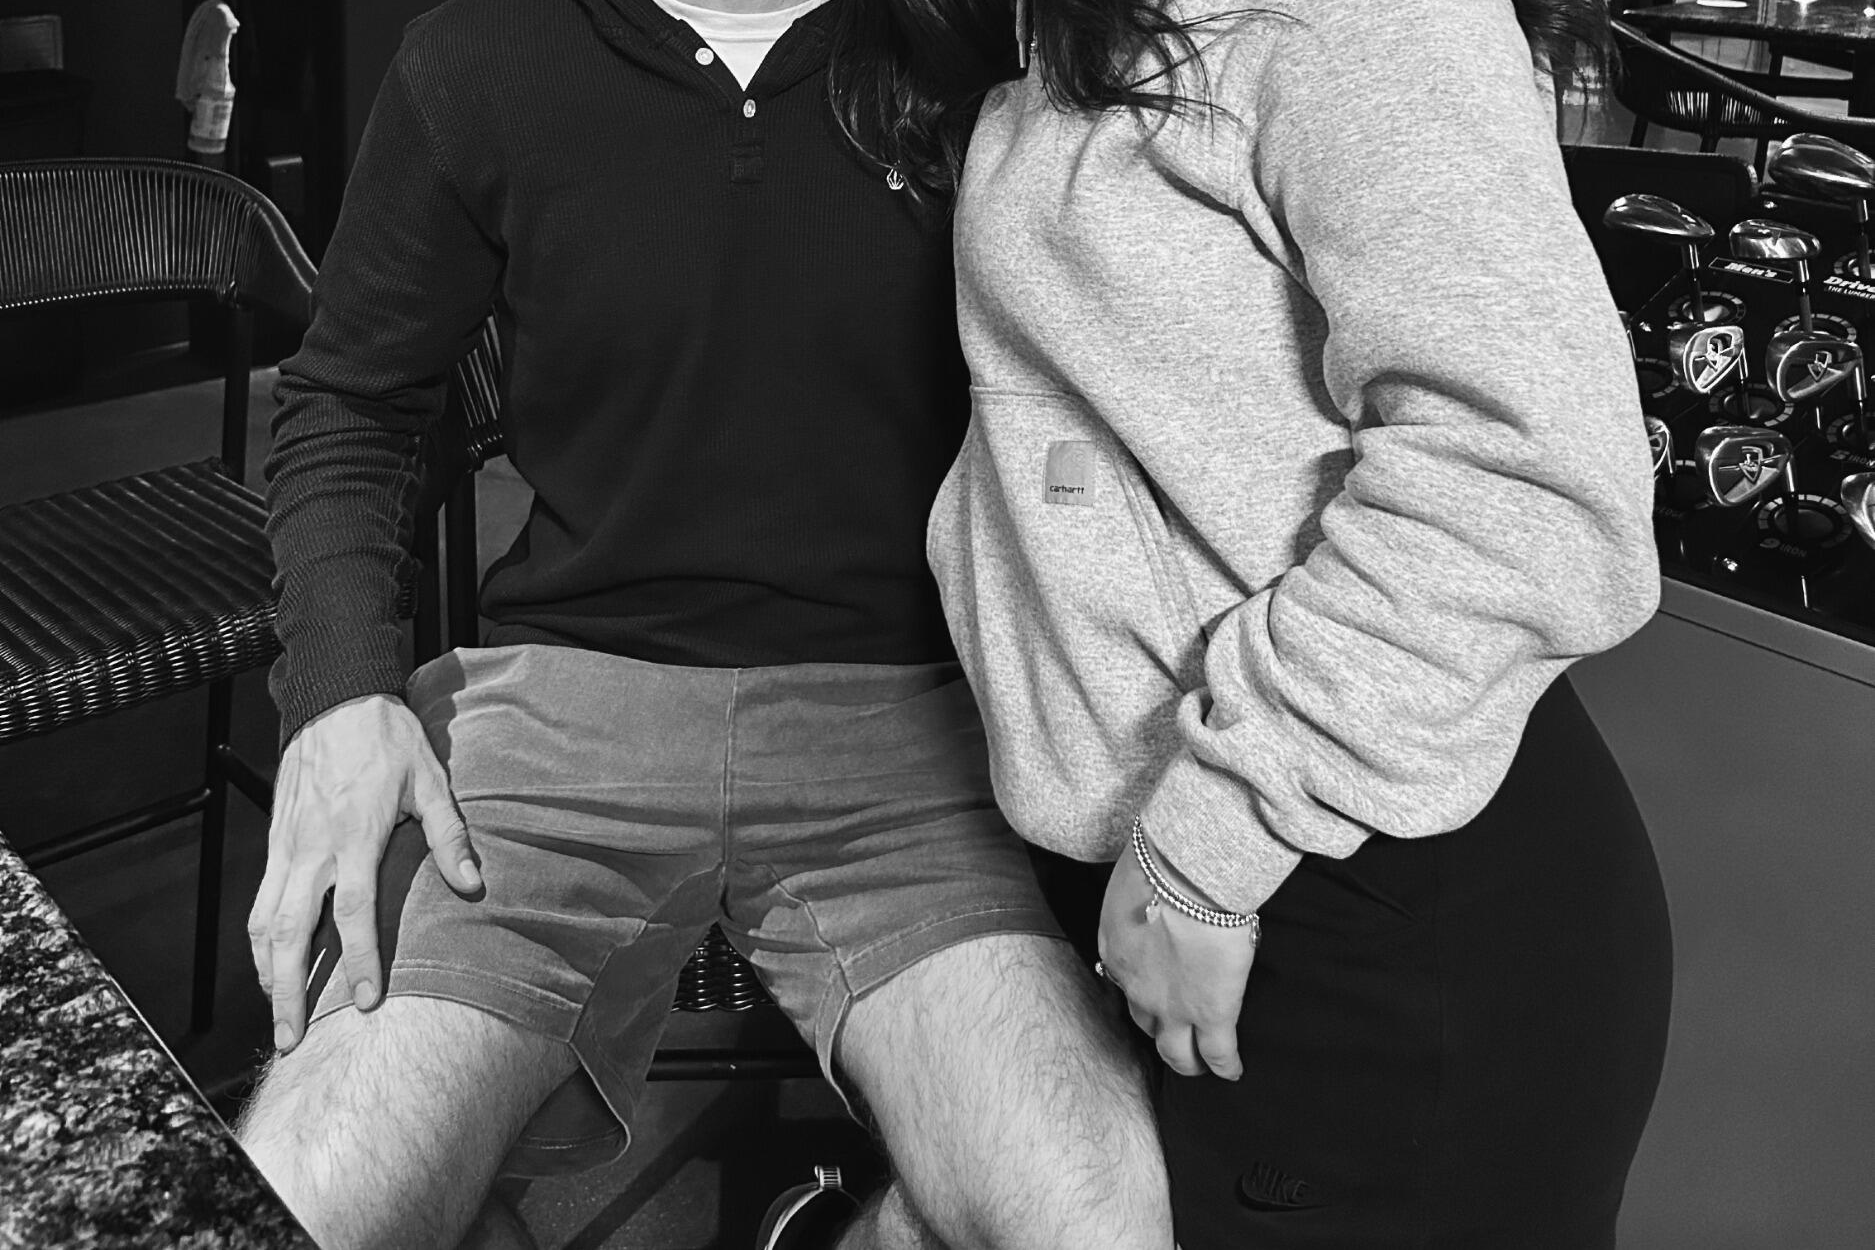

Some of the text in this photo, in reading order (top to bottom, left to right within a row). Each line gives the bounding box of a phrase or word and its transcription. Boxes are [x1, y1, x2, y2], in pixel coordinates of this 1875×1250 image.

[1724, 262, 1778, 278] Men's
[1049, 485, 1085, 494] carhartt
[1779, 543, 1808, 557] IRON
